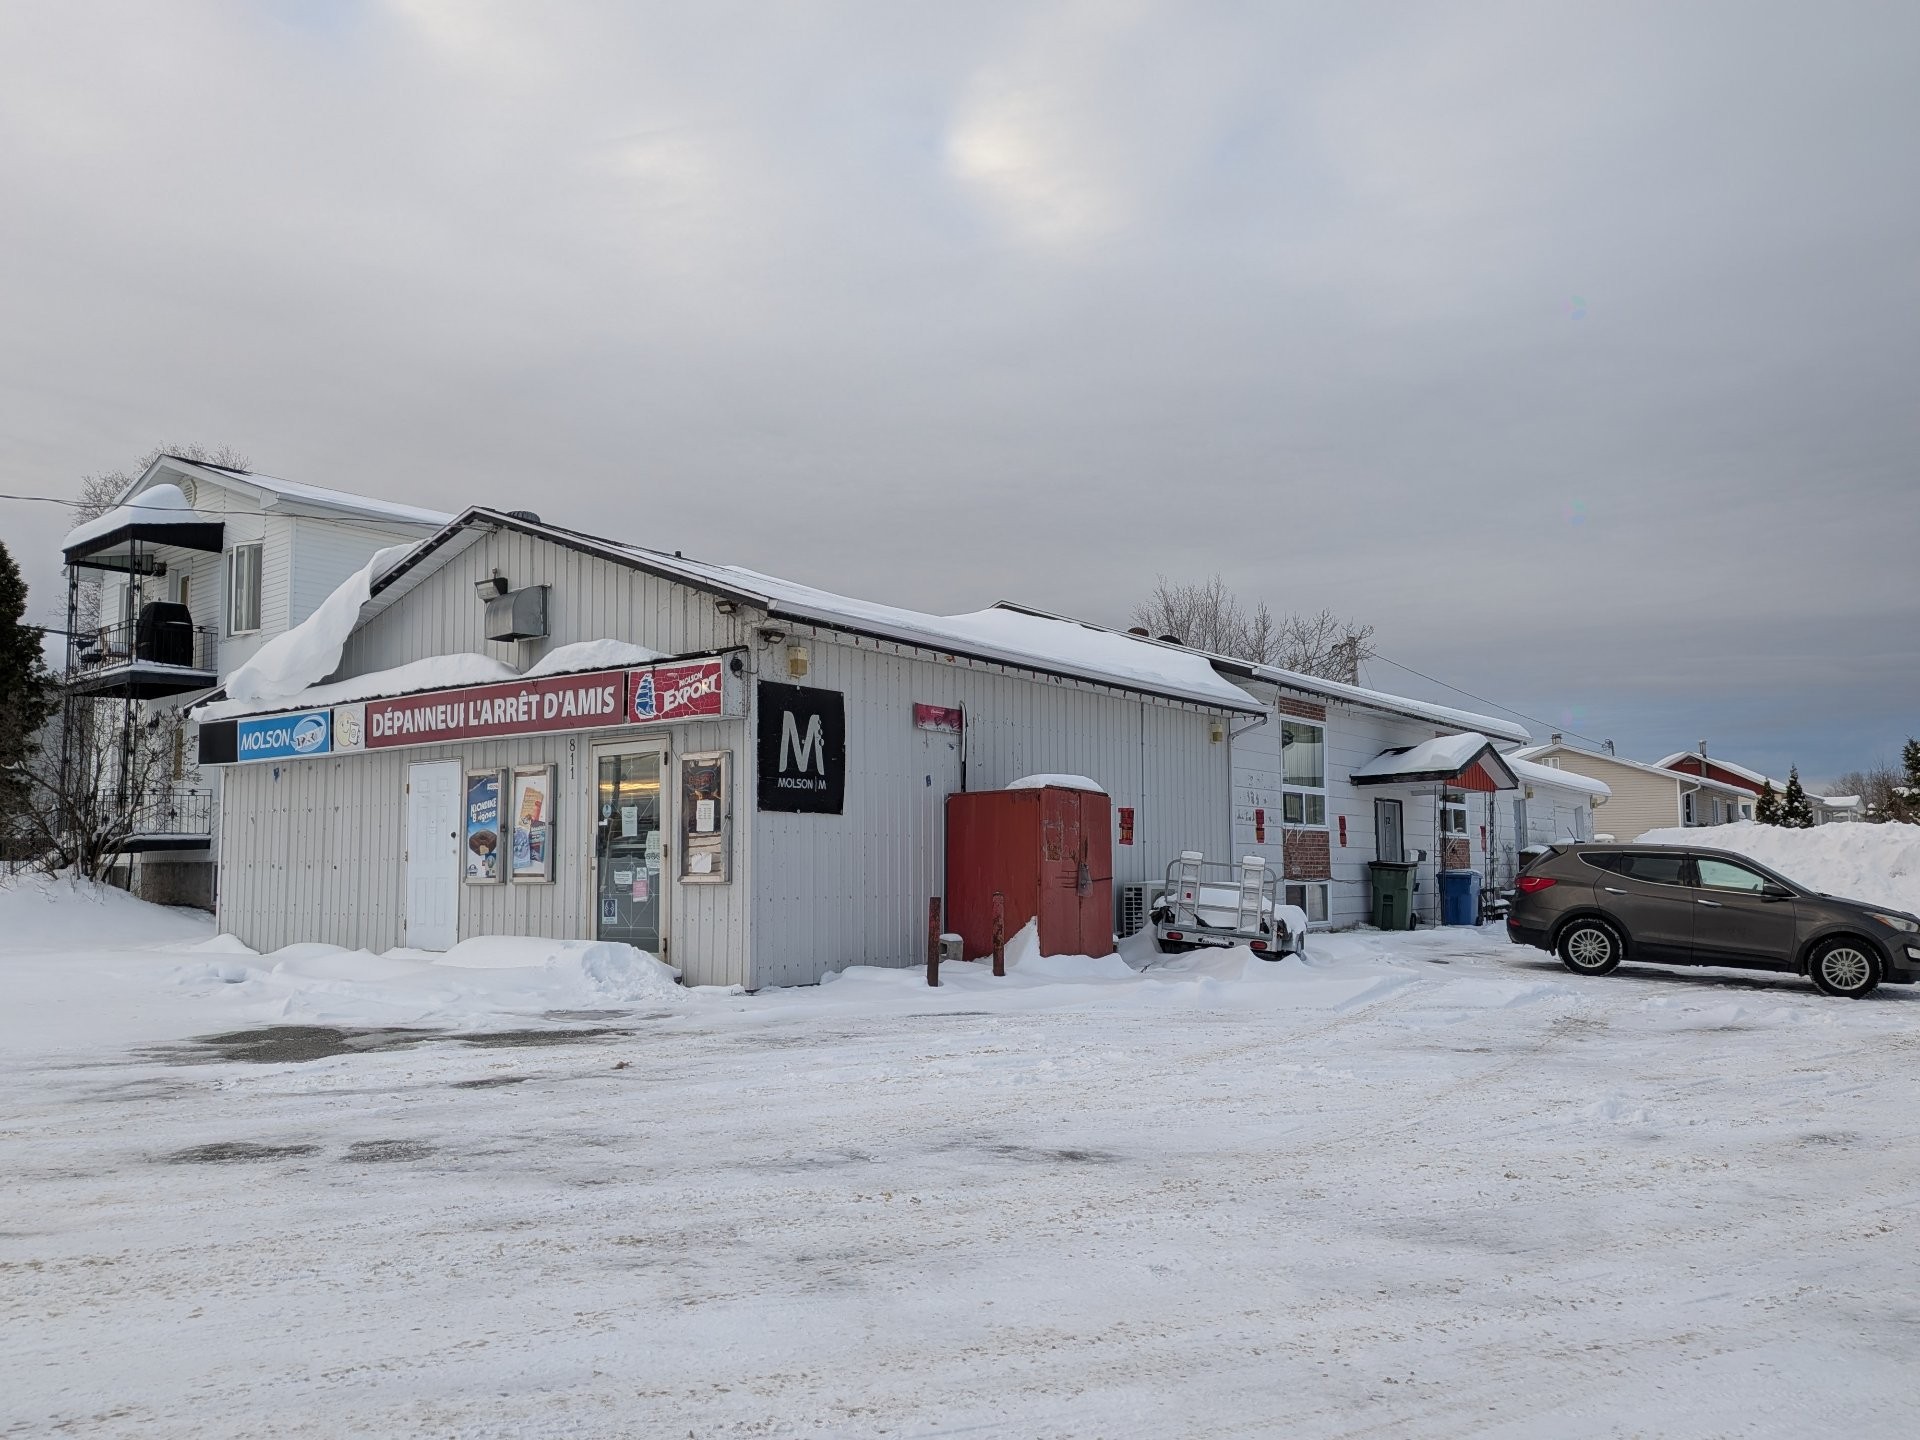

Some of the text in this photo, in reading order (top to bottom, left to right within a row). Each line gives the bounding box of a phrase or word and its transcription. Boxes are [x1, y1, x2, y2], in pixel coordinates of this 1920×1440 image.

[468, 690, 540, 726] L'ARRÊT
[543, 685, 616, 719] D'AMIS
[663, 673, 718, 711] EXPORT
[240, 728, 291, 751] MOLSON
[779, 710, 825, 776] M
[777, 777, 827, 791] MOLSON M
[472, 810, 496, 823] Bignes
